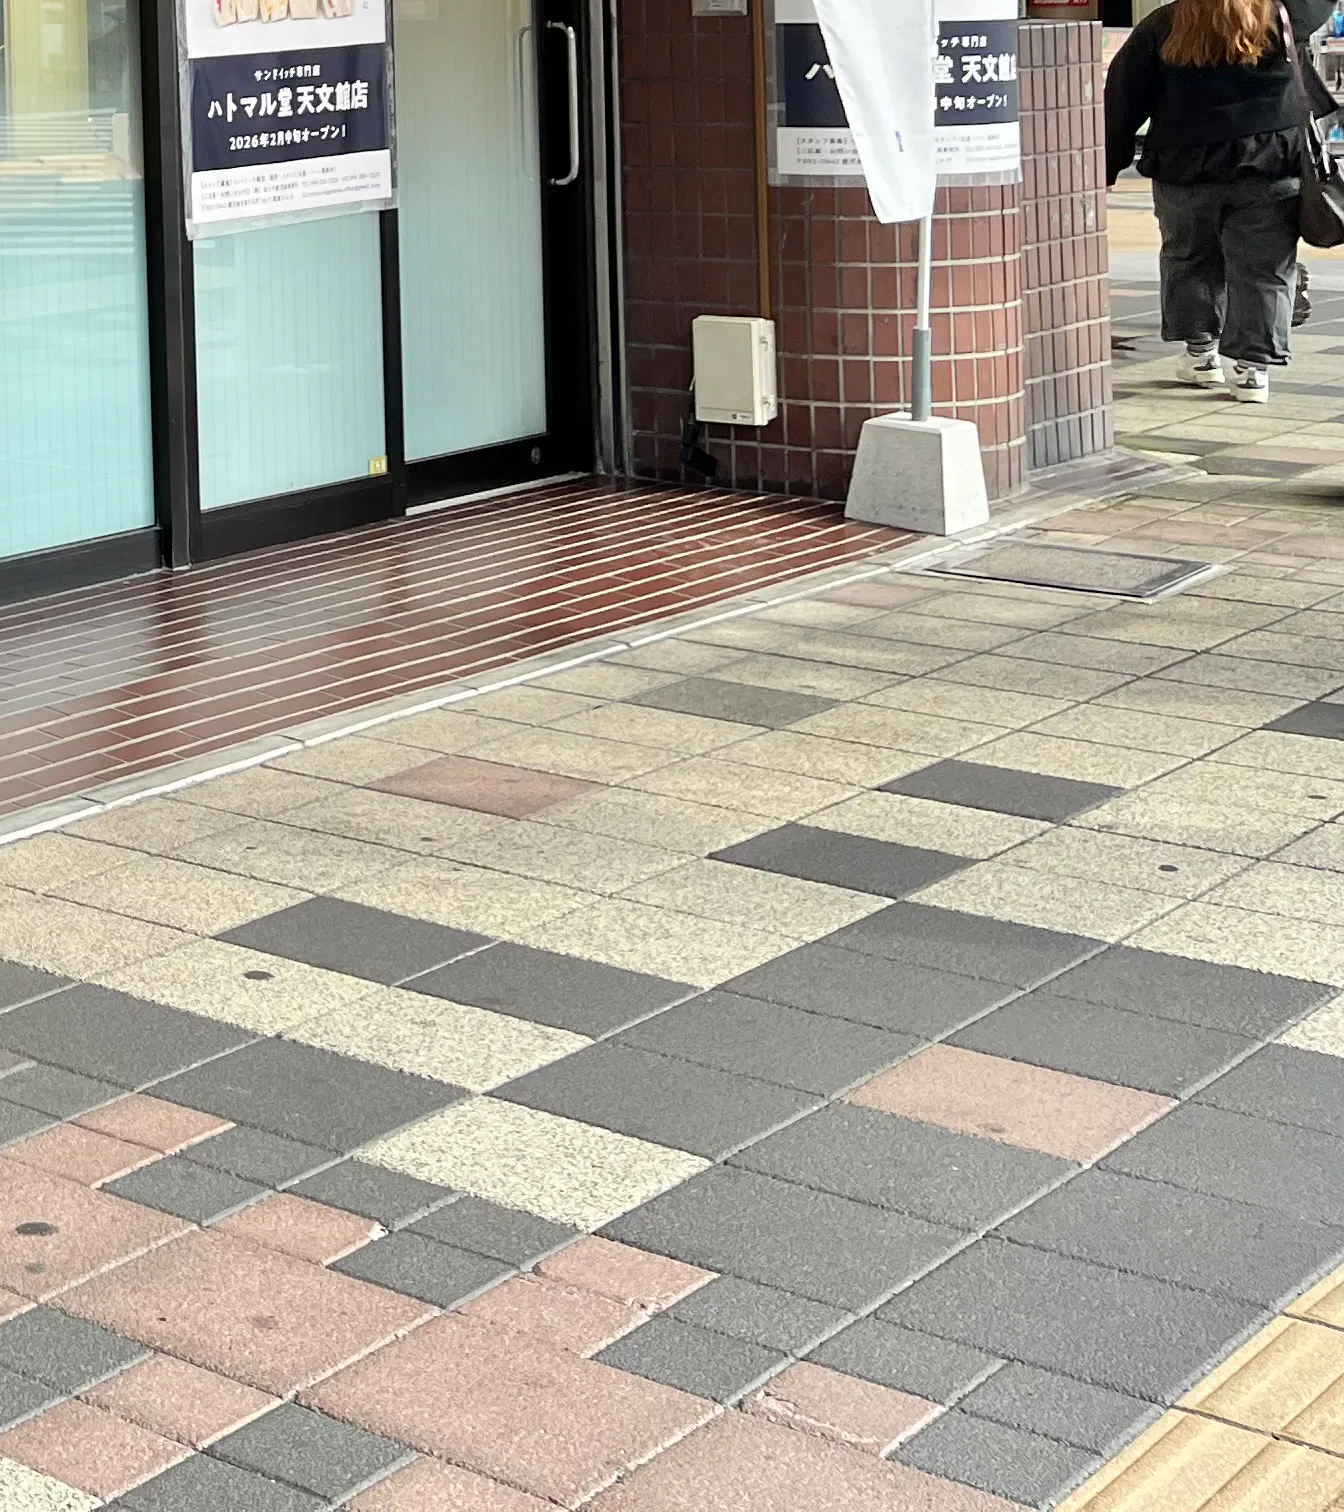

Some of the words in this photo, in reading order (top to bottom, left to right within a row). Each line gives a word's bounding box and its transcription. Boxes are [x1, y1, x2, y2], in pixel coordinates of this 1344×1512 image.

[254, 65, 321, 82] サンドイッチ専門店
[208, 88, 293, 123] ハトマル堂
[297, 80, 368, 114] 天文館店
[935, 95, 1008, 111] 中旬オープン!
